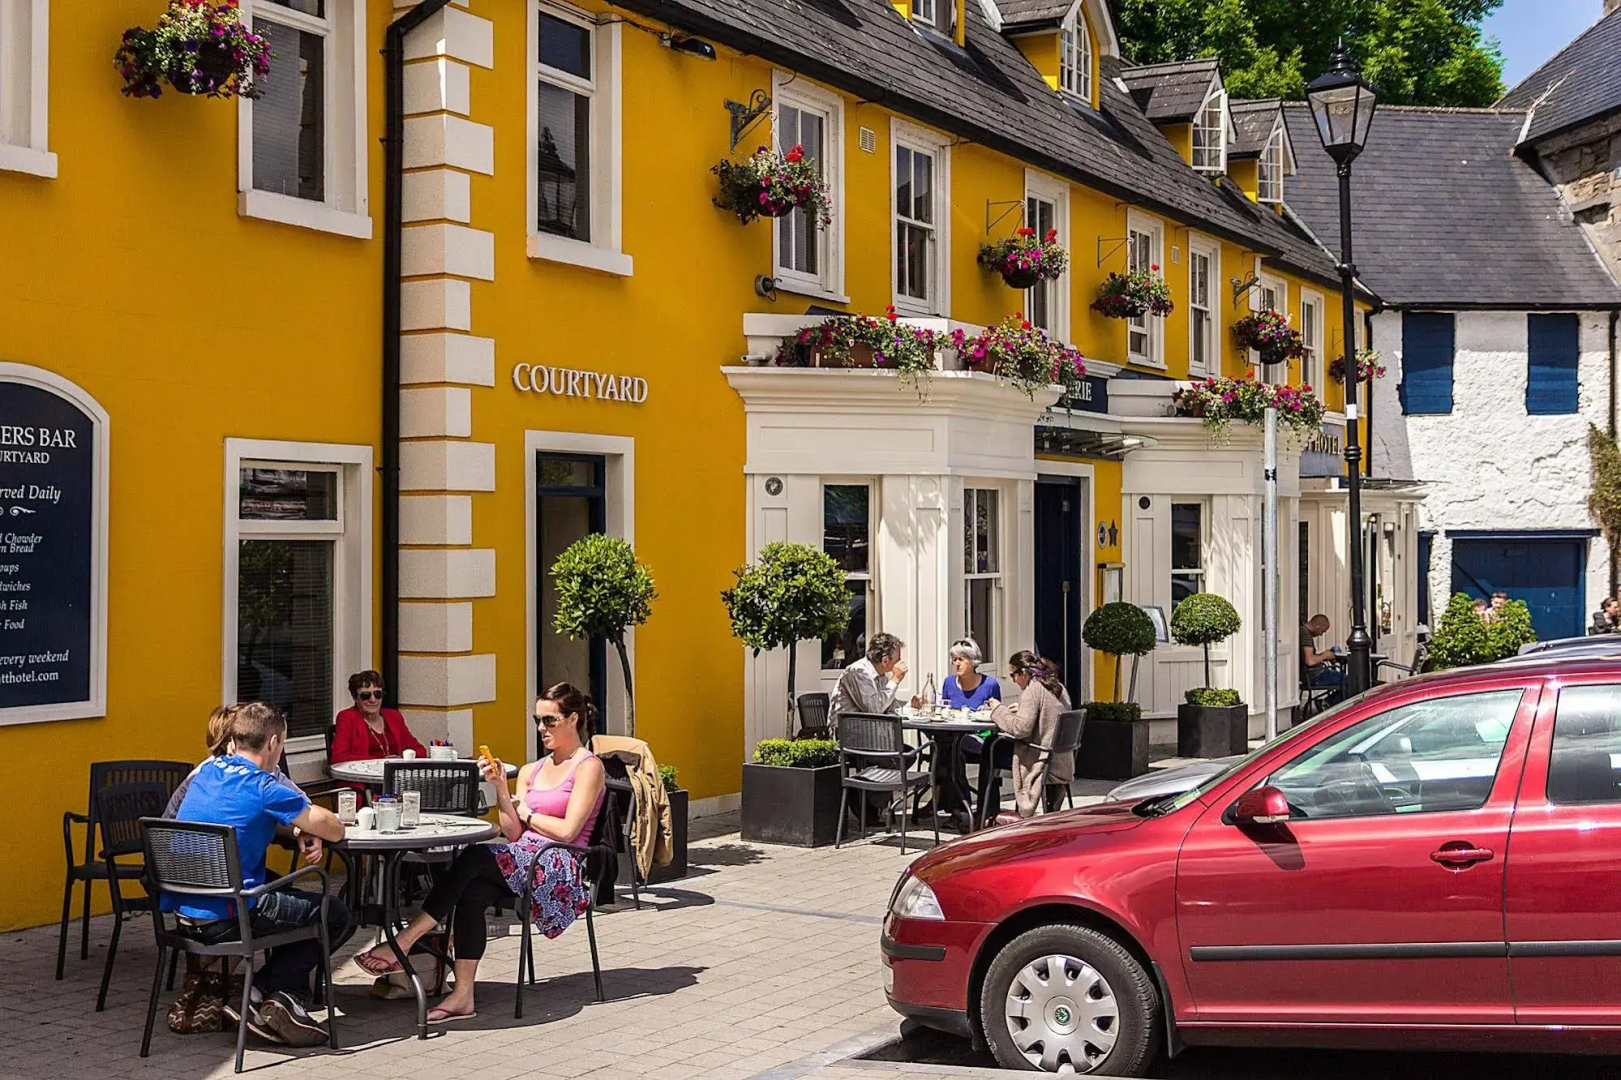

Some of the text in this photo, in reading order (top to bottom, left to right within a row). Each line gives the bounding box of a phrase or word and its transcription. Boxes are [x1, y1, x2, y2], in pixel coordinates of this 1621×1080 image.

[512, 362, 648, 403] COURTYARD
[0, 425, 77, 449] ERS BAR
[1314, 432, 1342, 455] HOTEL
[0, 484, 61, 505] rved Daily
[4, 532, 43, 544] Chowder
[9, 542, 35, 553] Bread
[9, 599, 28, 611] Fish
[4, 618, 25, 630] Food
[28, 649, 70, 664] weekend
